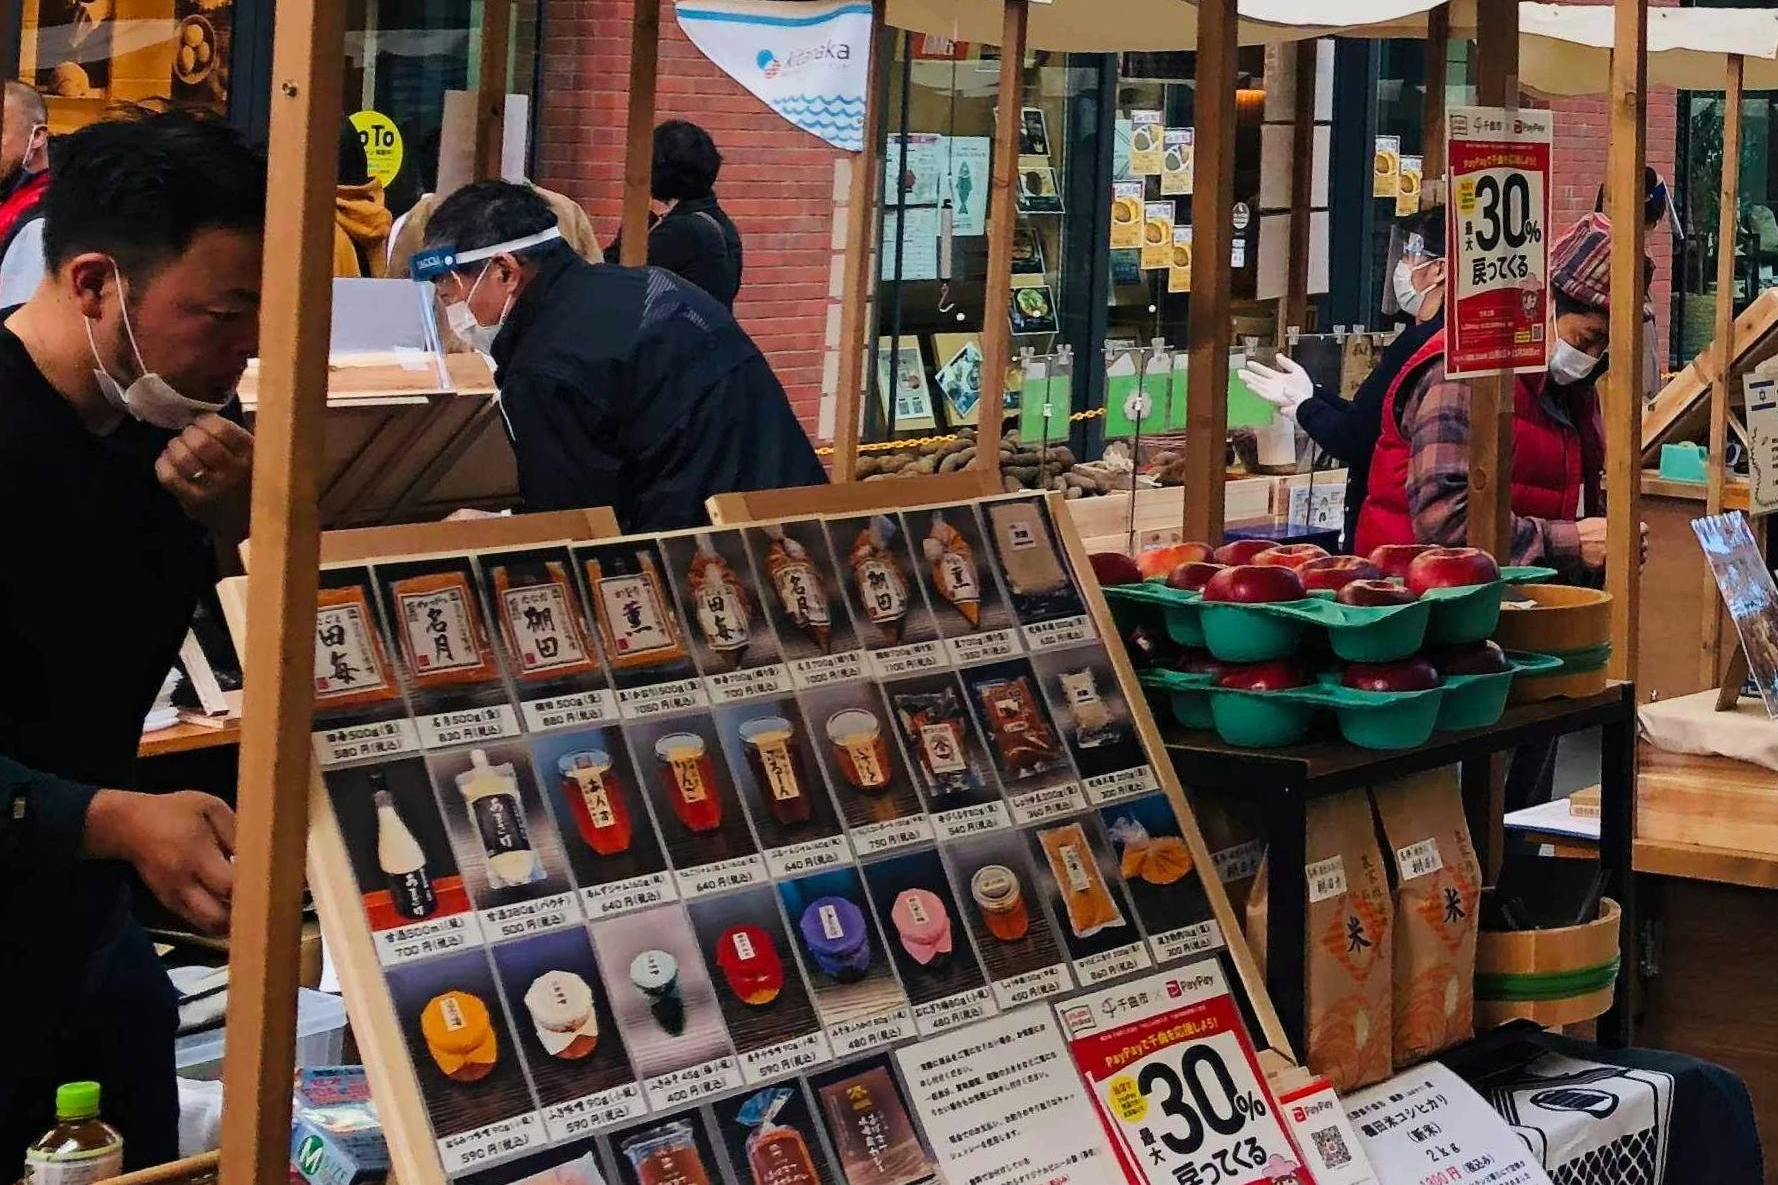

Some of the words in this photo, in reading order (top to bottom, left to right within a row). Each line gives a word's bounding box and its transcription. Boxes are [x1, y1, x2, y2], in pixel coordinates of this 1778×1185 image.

[1475, 173, 1541, 251] 30%
[1472, 254, 1529, 285] 戻ってくる
[1443, 887, 1466, 923] 米
[1347, 916, 1373, 953] 米
[1181, 974, 1214, 993] PayPay
[1138, 1044, 1266, 1155] 30%
[1304, 1100, 1334, 1116] PayPay
[1139, 1127, 1167, 1165] 最大
